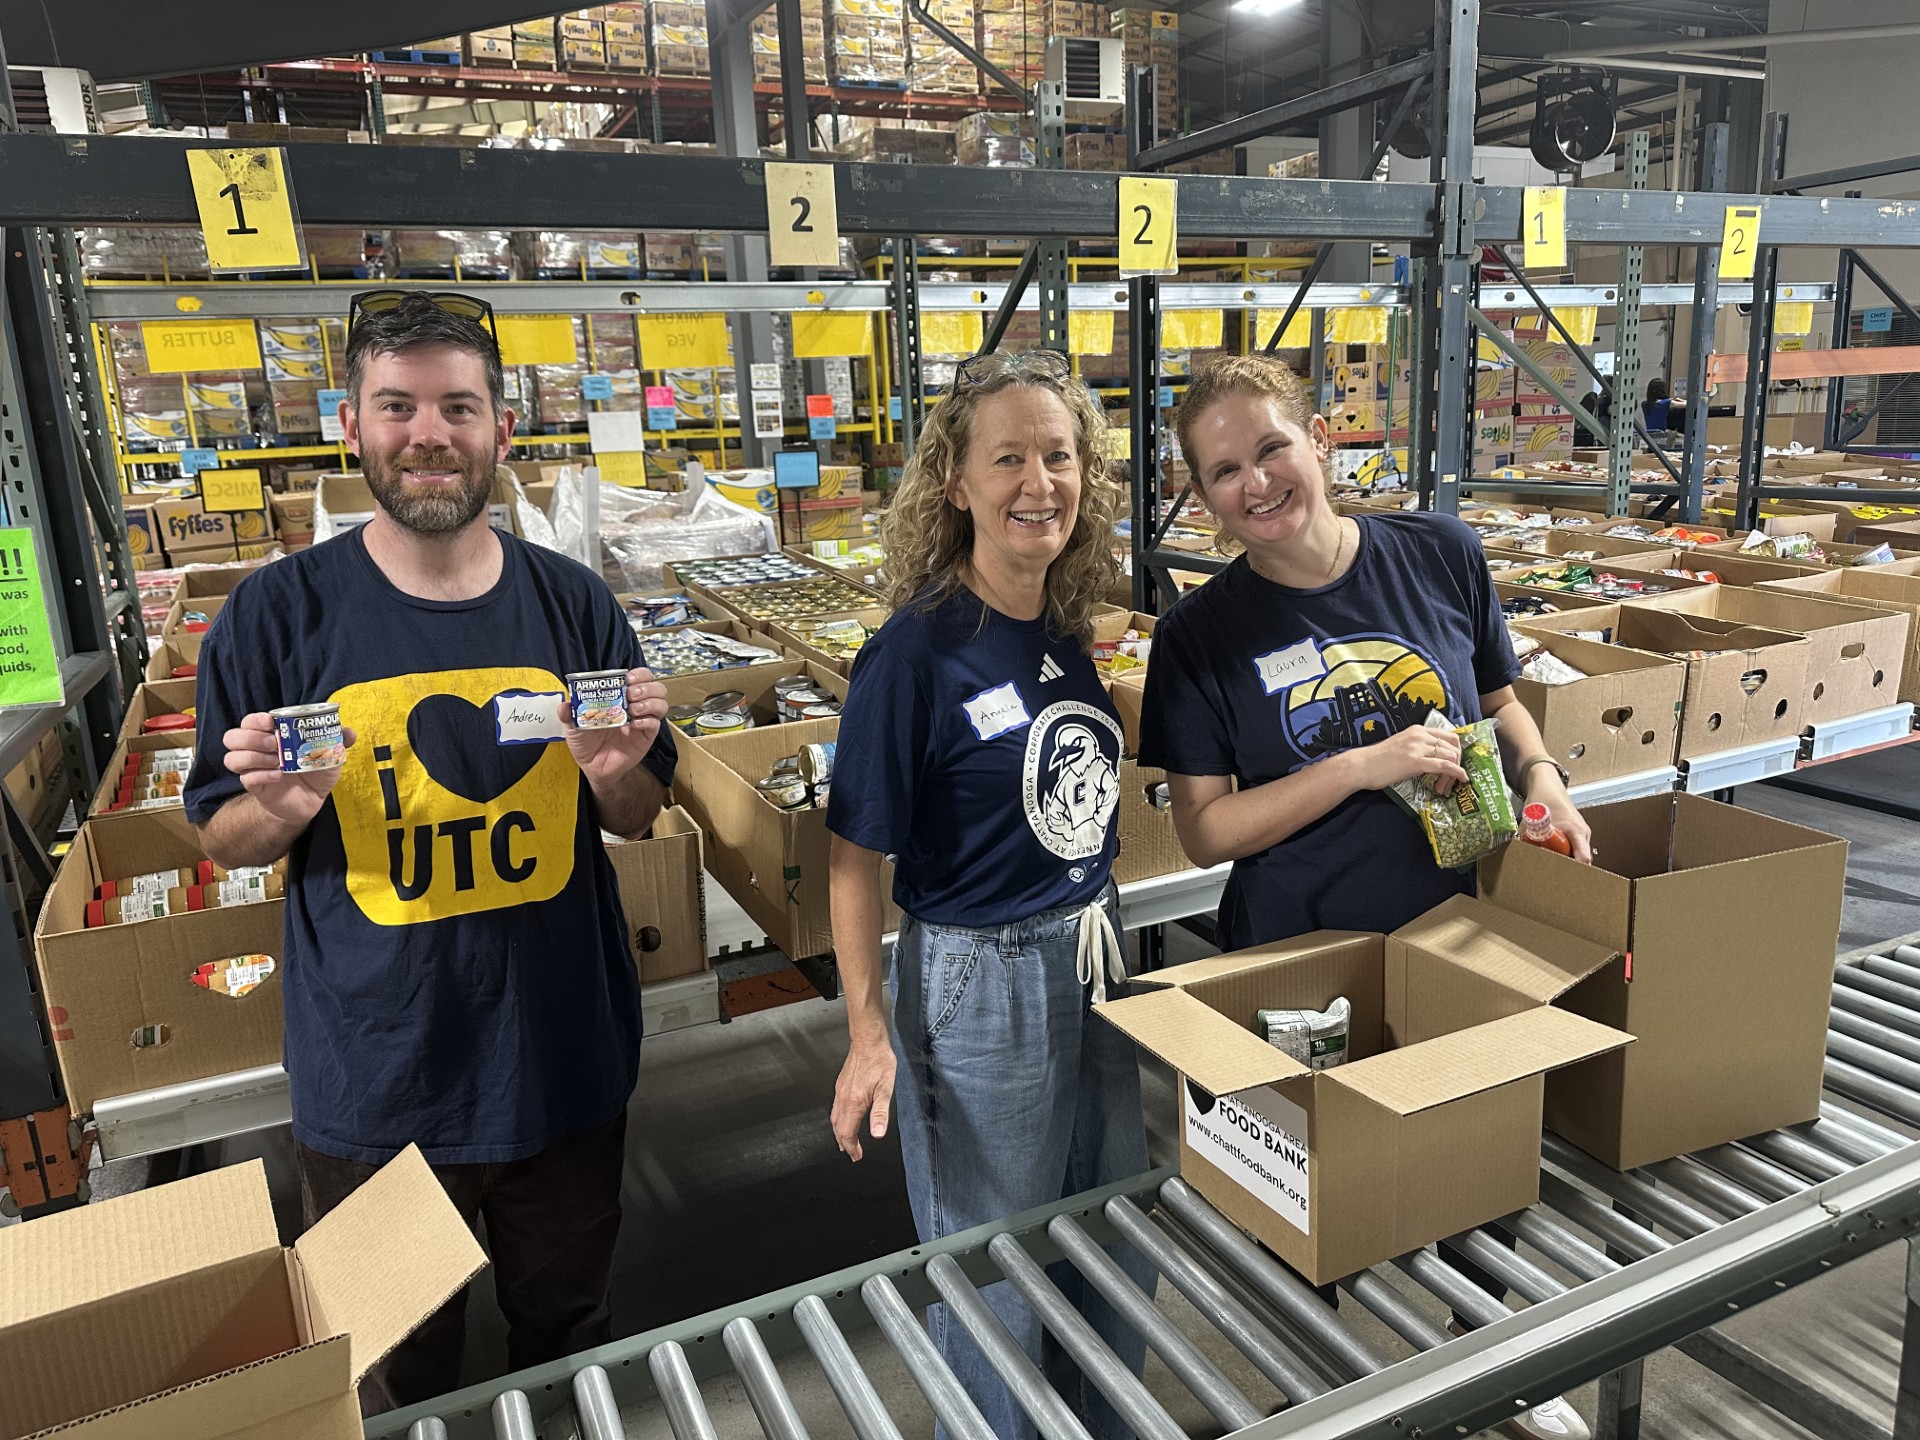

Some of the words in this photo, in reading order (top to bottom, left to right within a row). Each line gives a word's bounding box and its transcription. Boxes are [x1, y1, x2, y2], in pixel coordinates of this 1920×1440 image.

[81, 83, 98, 133] EZNOR
[219, 183, 258, 235] 1
[790, 197, 813, 233] 2
[1132, 205, 1154, 245] 2
[1534, 211, 1548, 245] 1
[1731, 228, 1746, 255] 2
[281, 414, 310, 430] fyffes
[1480, 422, 1511, 443] fyffes
[168, 514, 224, 541] fyffes
[1, 589, 29, 600] was
[0, 624, 28, 637] with
[1266, 655, 1308, 678] Laura
[576, 678, 620, 690] ARMOUR
[577, 690, 597, 701] Vienna
[597, 688, 621, 700] Sausage
[505, 708, 546, 724] Andrew
[980, 703, 1018, 725] Angela
[298, 727, 324, 741] Vienna
[1028, 713, 1052, 763] CORPORATE
[1050, 703, 1099, 717] CHALLENGE
[373, 744, 403, 821] i
[1073, 779, 1086, 806] C
[1481, 768, 1500, 797] PEAS
[1026, 777, 1053, 846] CHATTANOOGA
[1478, 782, 1500, 822] GREEN
[386, 810, 538, 902] UTC
[1054, 844, 1067, 854] AT
[1219, 1100, 1261, 1141] FOOD
[1264, 1132, 1308, 1175] BANK
[1222, 1094, 1281, 1137] HATTANOOGA
[1283, 1131, 1307, 1154] AREA
[1188, 1114, 1307, 1211] www.chattfoodbank.org
